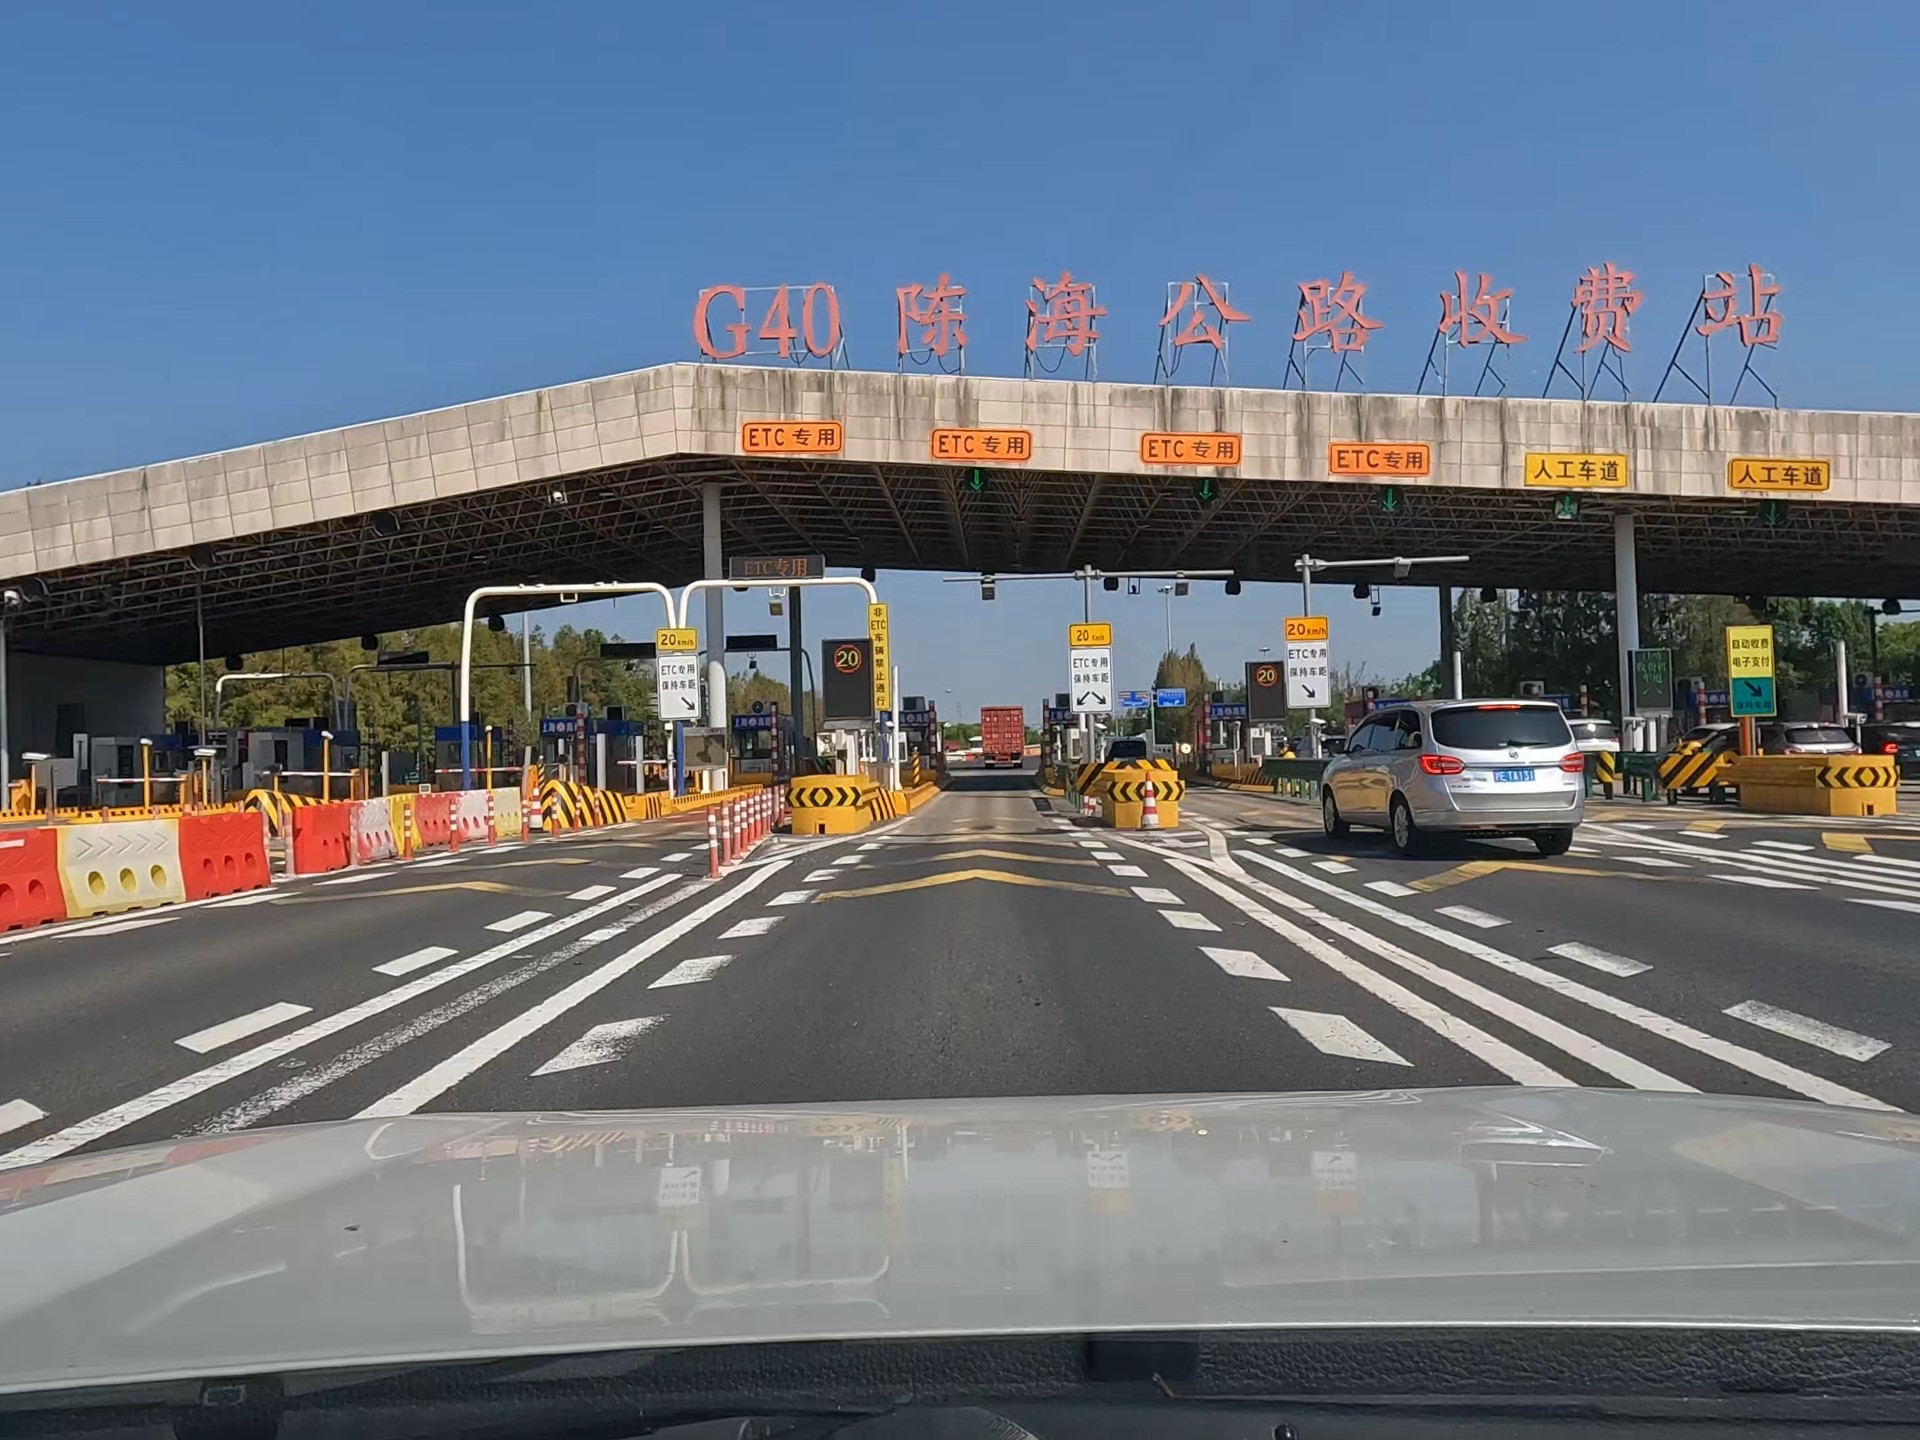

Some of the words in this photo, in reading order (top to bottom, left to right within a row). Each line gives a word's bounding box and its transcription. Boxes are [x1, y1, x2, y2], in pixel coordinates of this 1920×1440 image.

[693, 282, 841, 359] G40
[1533, 459, 1621, 482] 人工车道
[1737, 465, 1824, 487] 人工车道
[1732, 638, 1769, 650] 自动收费
[836, 650, 859, 667] 20
[1732, 656, 1770, 668] 电子支付
[1257, 669, 1275, 683] 20
[1290, 665, 1328, 678] 保持车距
[662, 679, 697, 691] 保持车距
[1074, 673, 1110, 684] 保持车距
